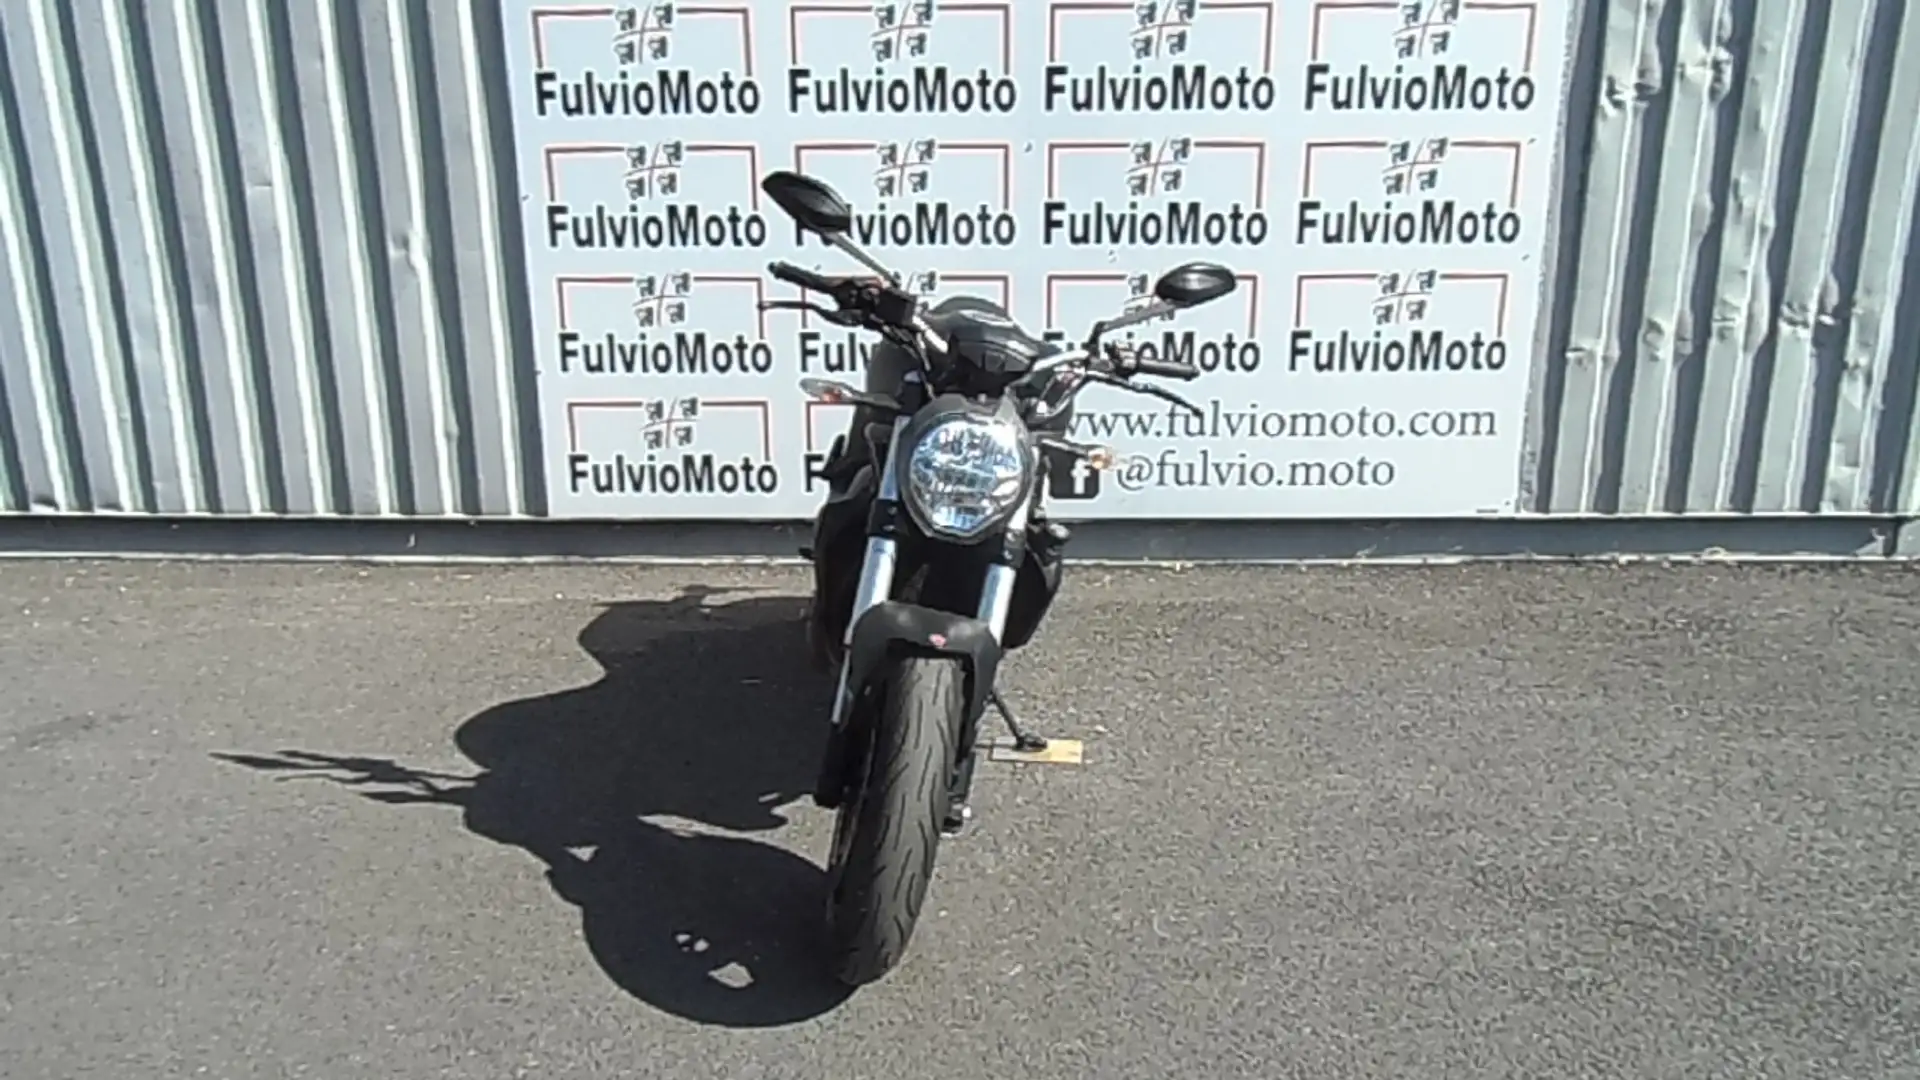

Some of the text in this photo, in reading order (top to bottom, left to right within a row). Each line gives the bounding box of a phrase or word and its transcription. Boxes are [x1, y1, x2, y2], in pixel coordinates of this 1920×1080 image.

[535, 70, 759, 115] FulvioMoto
[788, 67, 1015, 112] FulvioMoto
[1044, 64, 1275, 110] FulvioMoto
[1304, 63, 1536, 110] FulvioMoto
[547, 204, 765, 247] FulvioMoto
[797, 202, 1014, 246] lvioMoto
[1043, 201, 1267, 245] FulvioMoto
[1297, 200, 1520, 245] FulvioMoto
[558, 331, 772, 373] FulvioMoto
[1289, 330, 1507, 372] FulvioMoto
[569, 454, 777, 493] FulvioMoto
[1115, 449, 1396, 491] @fulvio.moto
